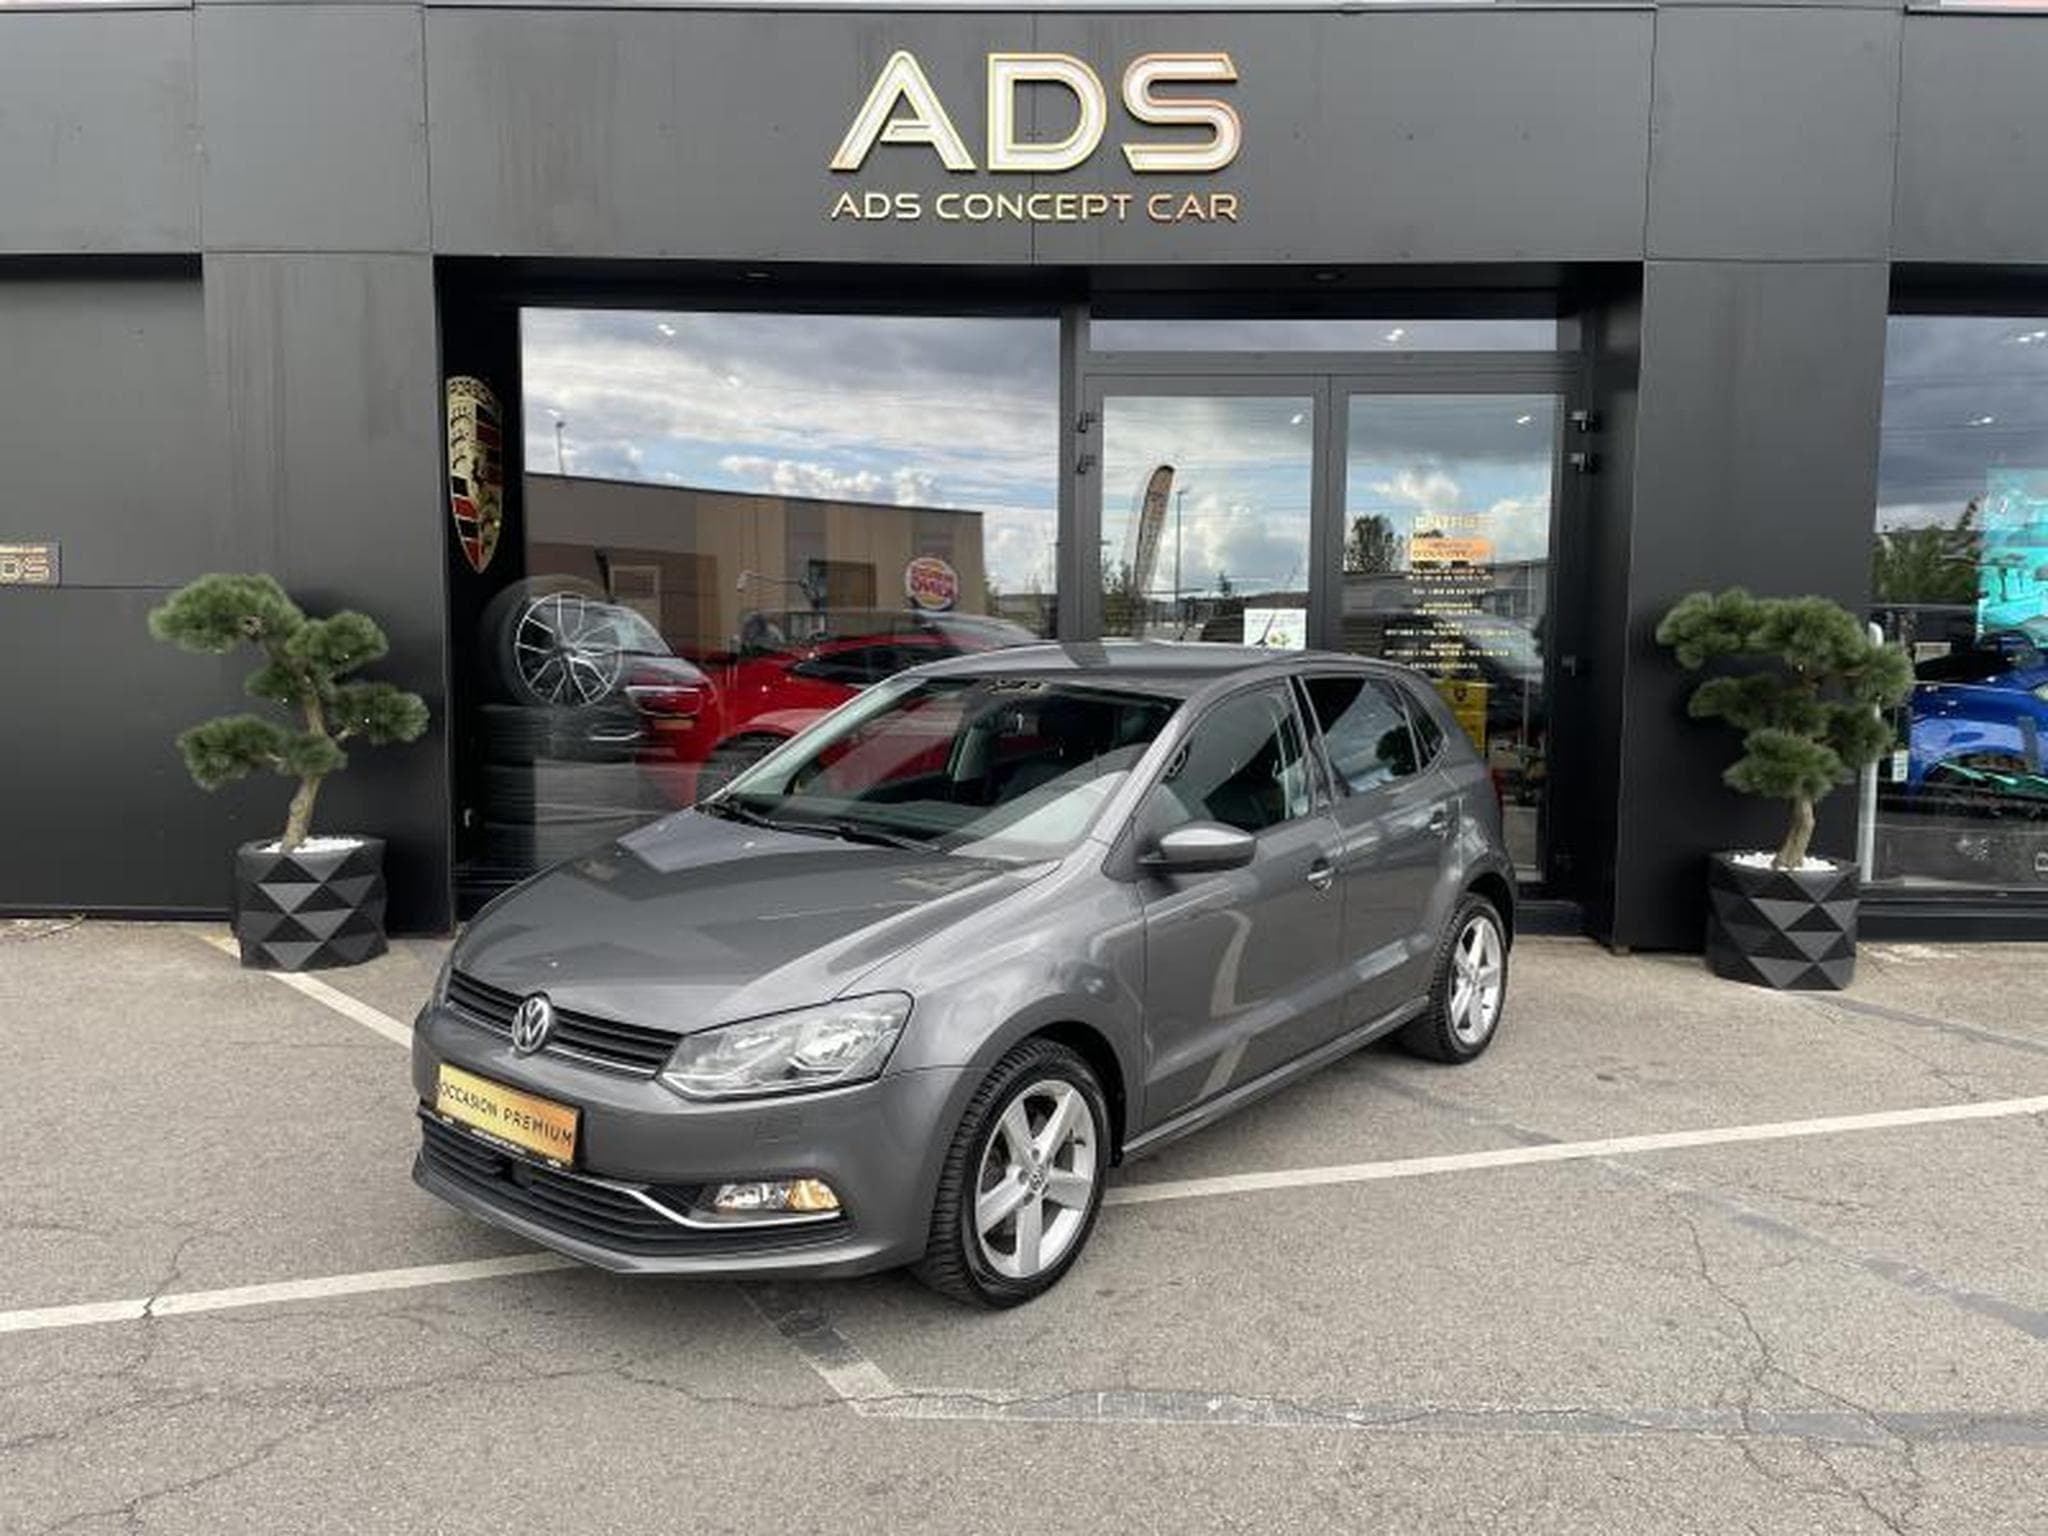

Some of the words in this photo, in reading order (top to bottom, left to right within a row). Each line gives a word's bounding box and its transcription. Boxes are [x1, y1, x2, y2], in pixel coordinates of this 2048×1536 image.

[829, 50, 1242, 172] ADS
[831, 192, 921, 220] ADS
[935, 192, 1131, 220] CONCEPT
[1146, 192, 1238, 221] CAR
[437, 1082, 498, 1117] OCCASION
[503, 1107, 573, 1146] PREMIUM
